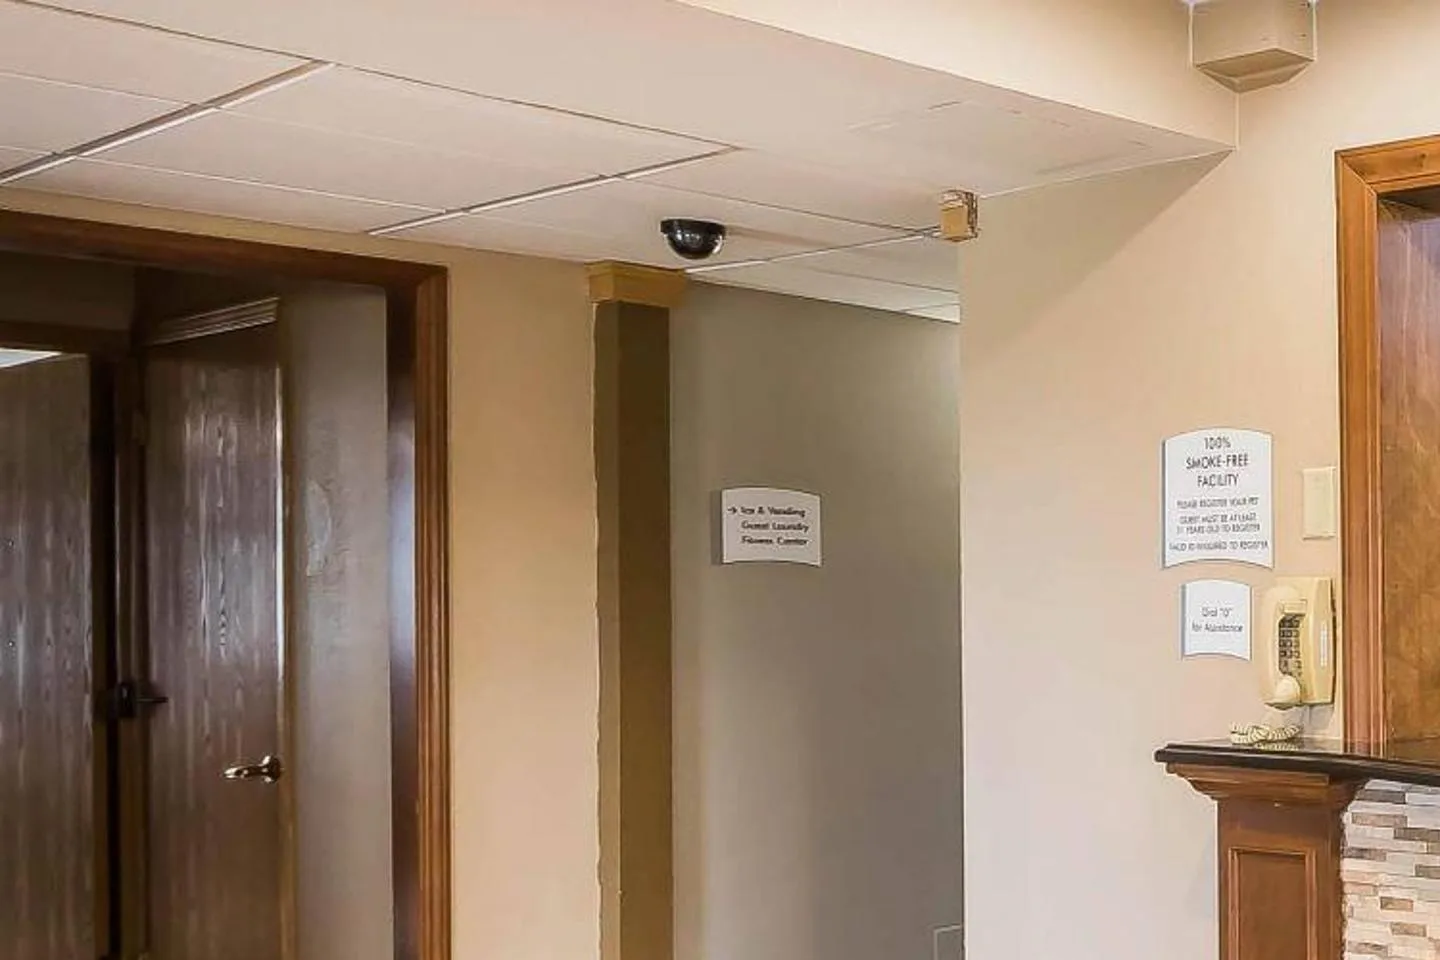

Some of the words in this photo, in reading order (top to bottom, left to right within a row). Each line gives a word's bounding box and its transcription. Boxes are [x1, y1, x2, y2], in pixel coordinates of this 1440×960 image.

[1203, 437, 1231, 450] 100%
[1185, 453, 1248, 470] SMOKE-FREE
[1197, 473, 1240, 488] FACILITY
[1201, 606, 1218, 617] Dial
